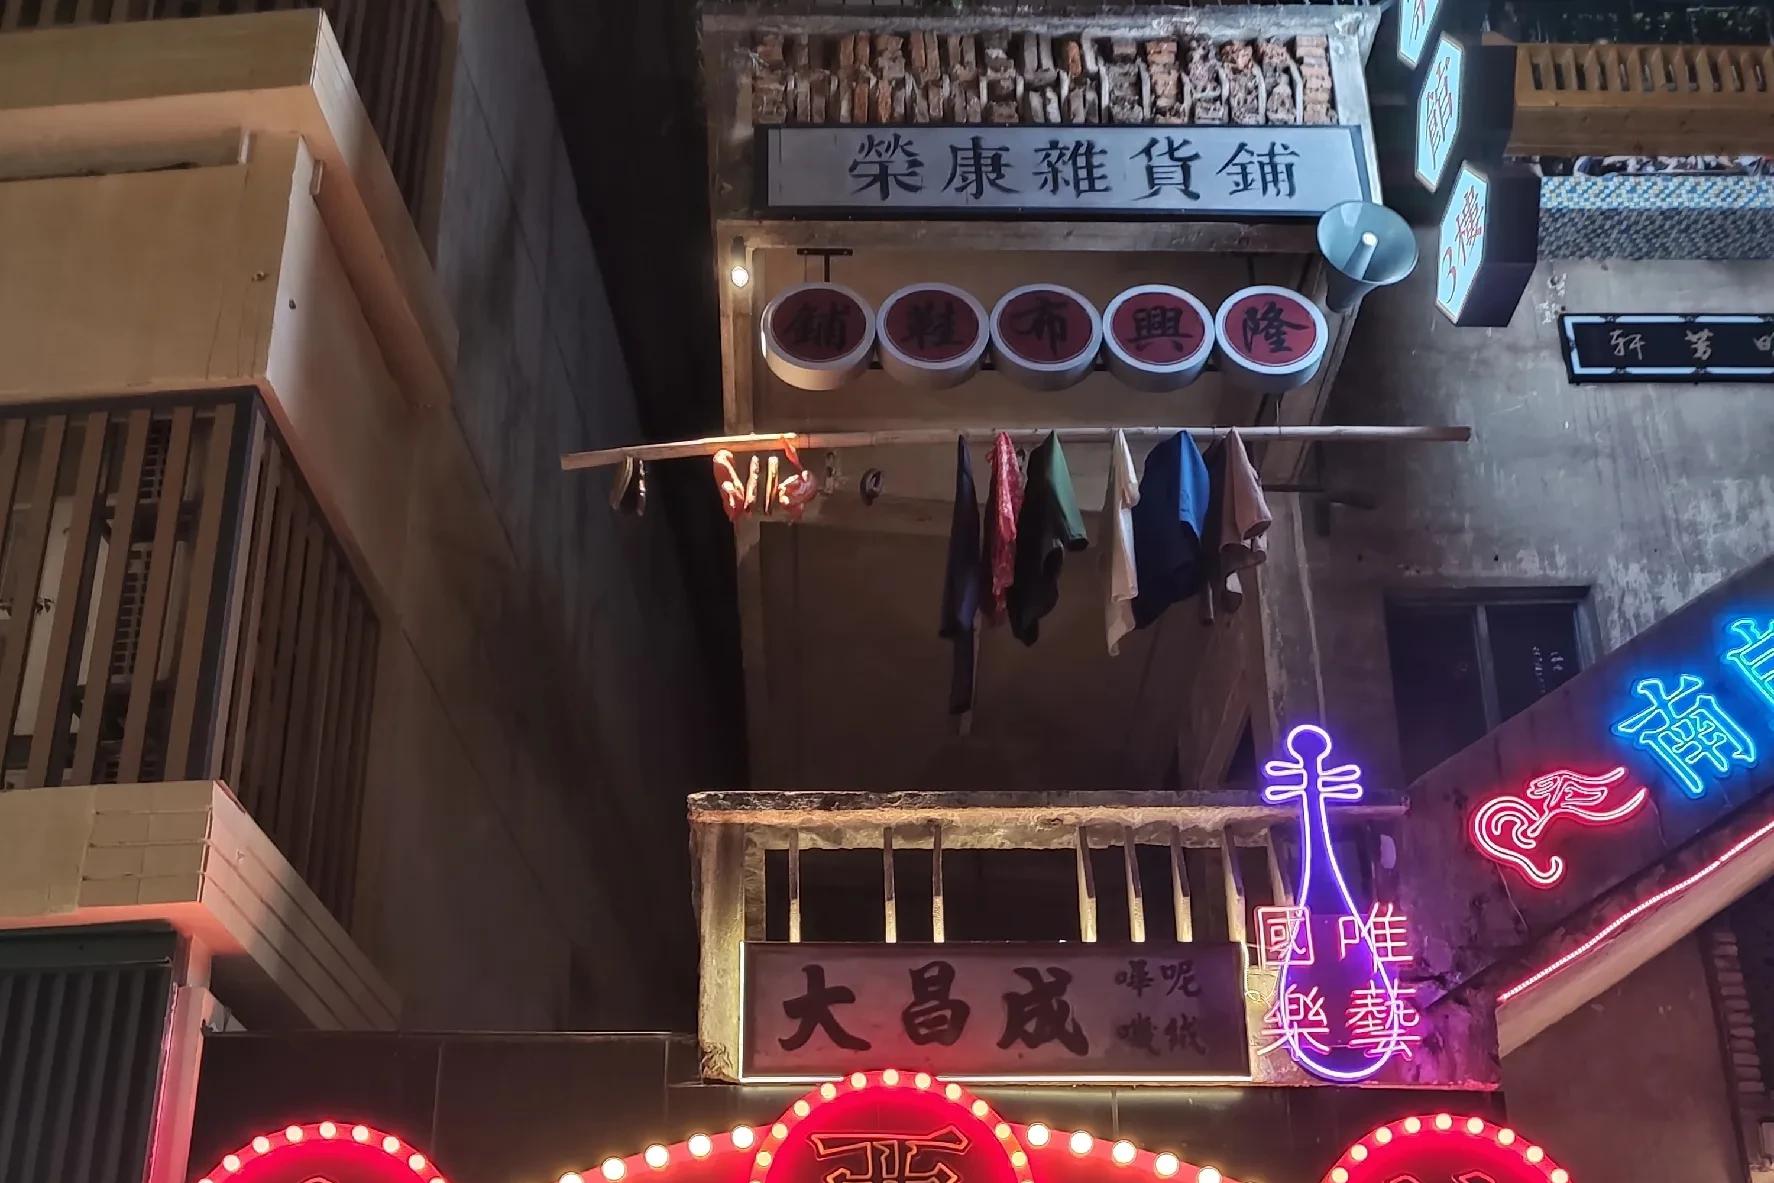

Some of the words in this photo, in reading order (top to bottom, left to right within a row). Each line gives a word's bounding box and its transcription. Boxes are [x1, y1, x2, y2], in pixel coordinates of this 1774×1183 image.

[848, 132, 1301, 202] 榮康雜貨鋪
[778, 960, 1090, 1057] 大昌成
